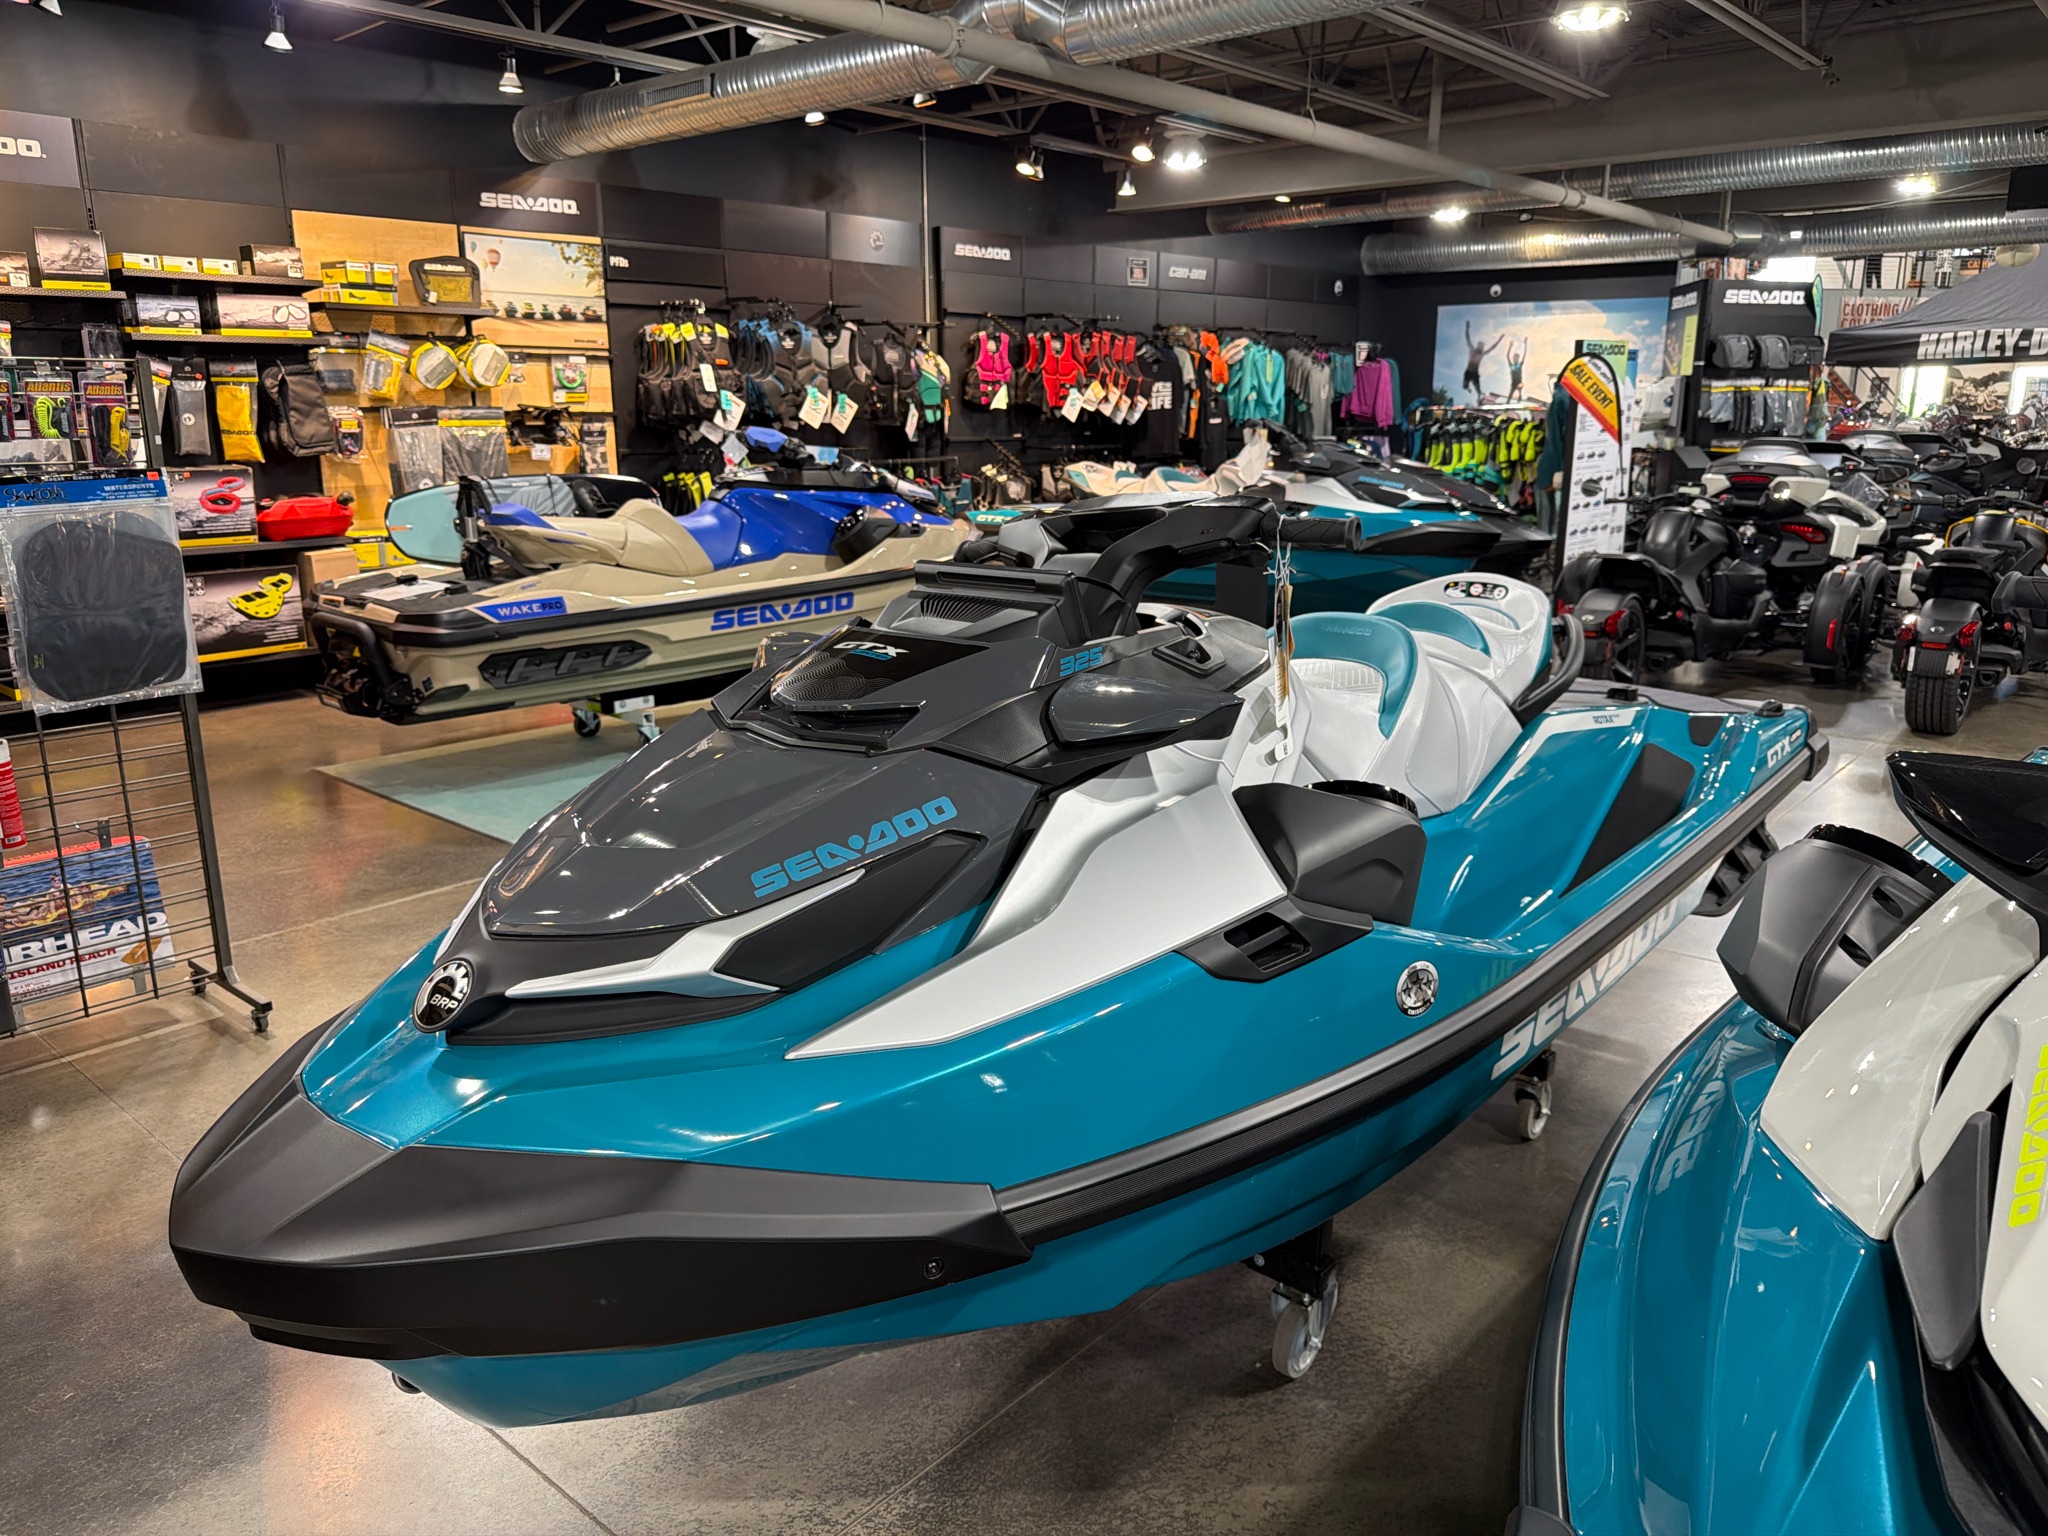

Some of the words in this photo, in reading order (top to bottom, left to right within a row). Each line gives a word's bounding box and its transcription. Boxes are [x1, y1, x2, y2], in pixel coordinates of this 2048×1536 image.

[1843, 303, 1899, 317] CLOTHING
[26, 381, 71, 393] Atlantis
[86, 384, 123, 395] Atlantis
[1569, 363, 1593, 388] SALE
[1587, 382, 1614, 409] EVENT
[103, 482, 155, 491] WATERSPORTS
[833, 641, 910, 657] GTX
[1059, 646, 1103, 677] 325
[1766, 735, 1791, 769] GTX
[9, 960, 66, 980] ISLAND
[430, 993, 459, 1010] BRP
